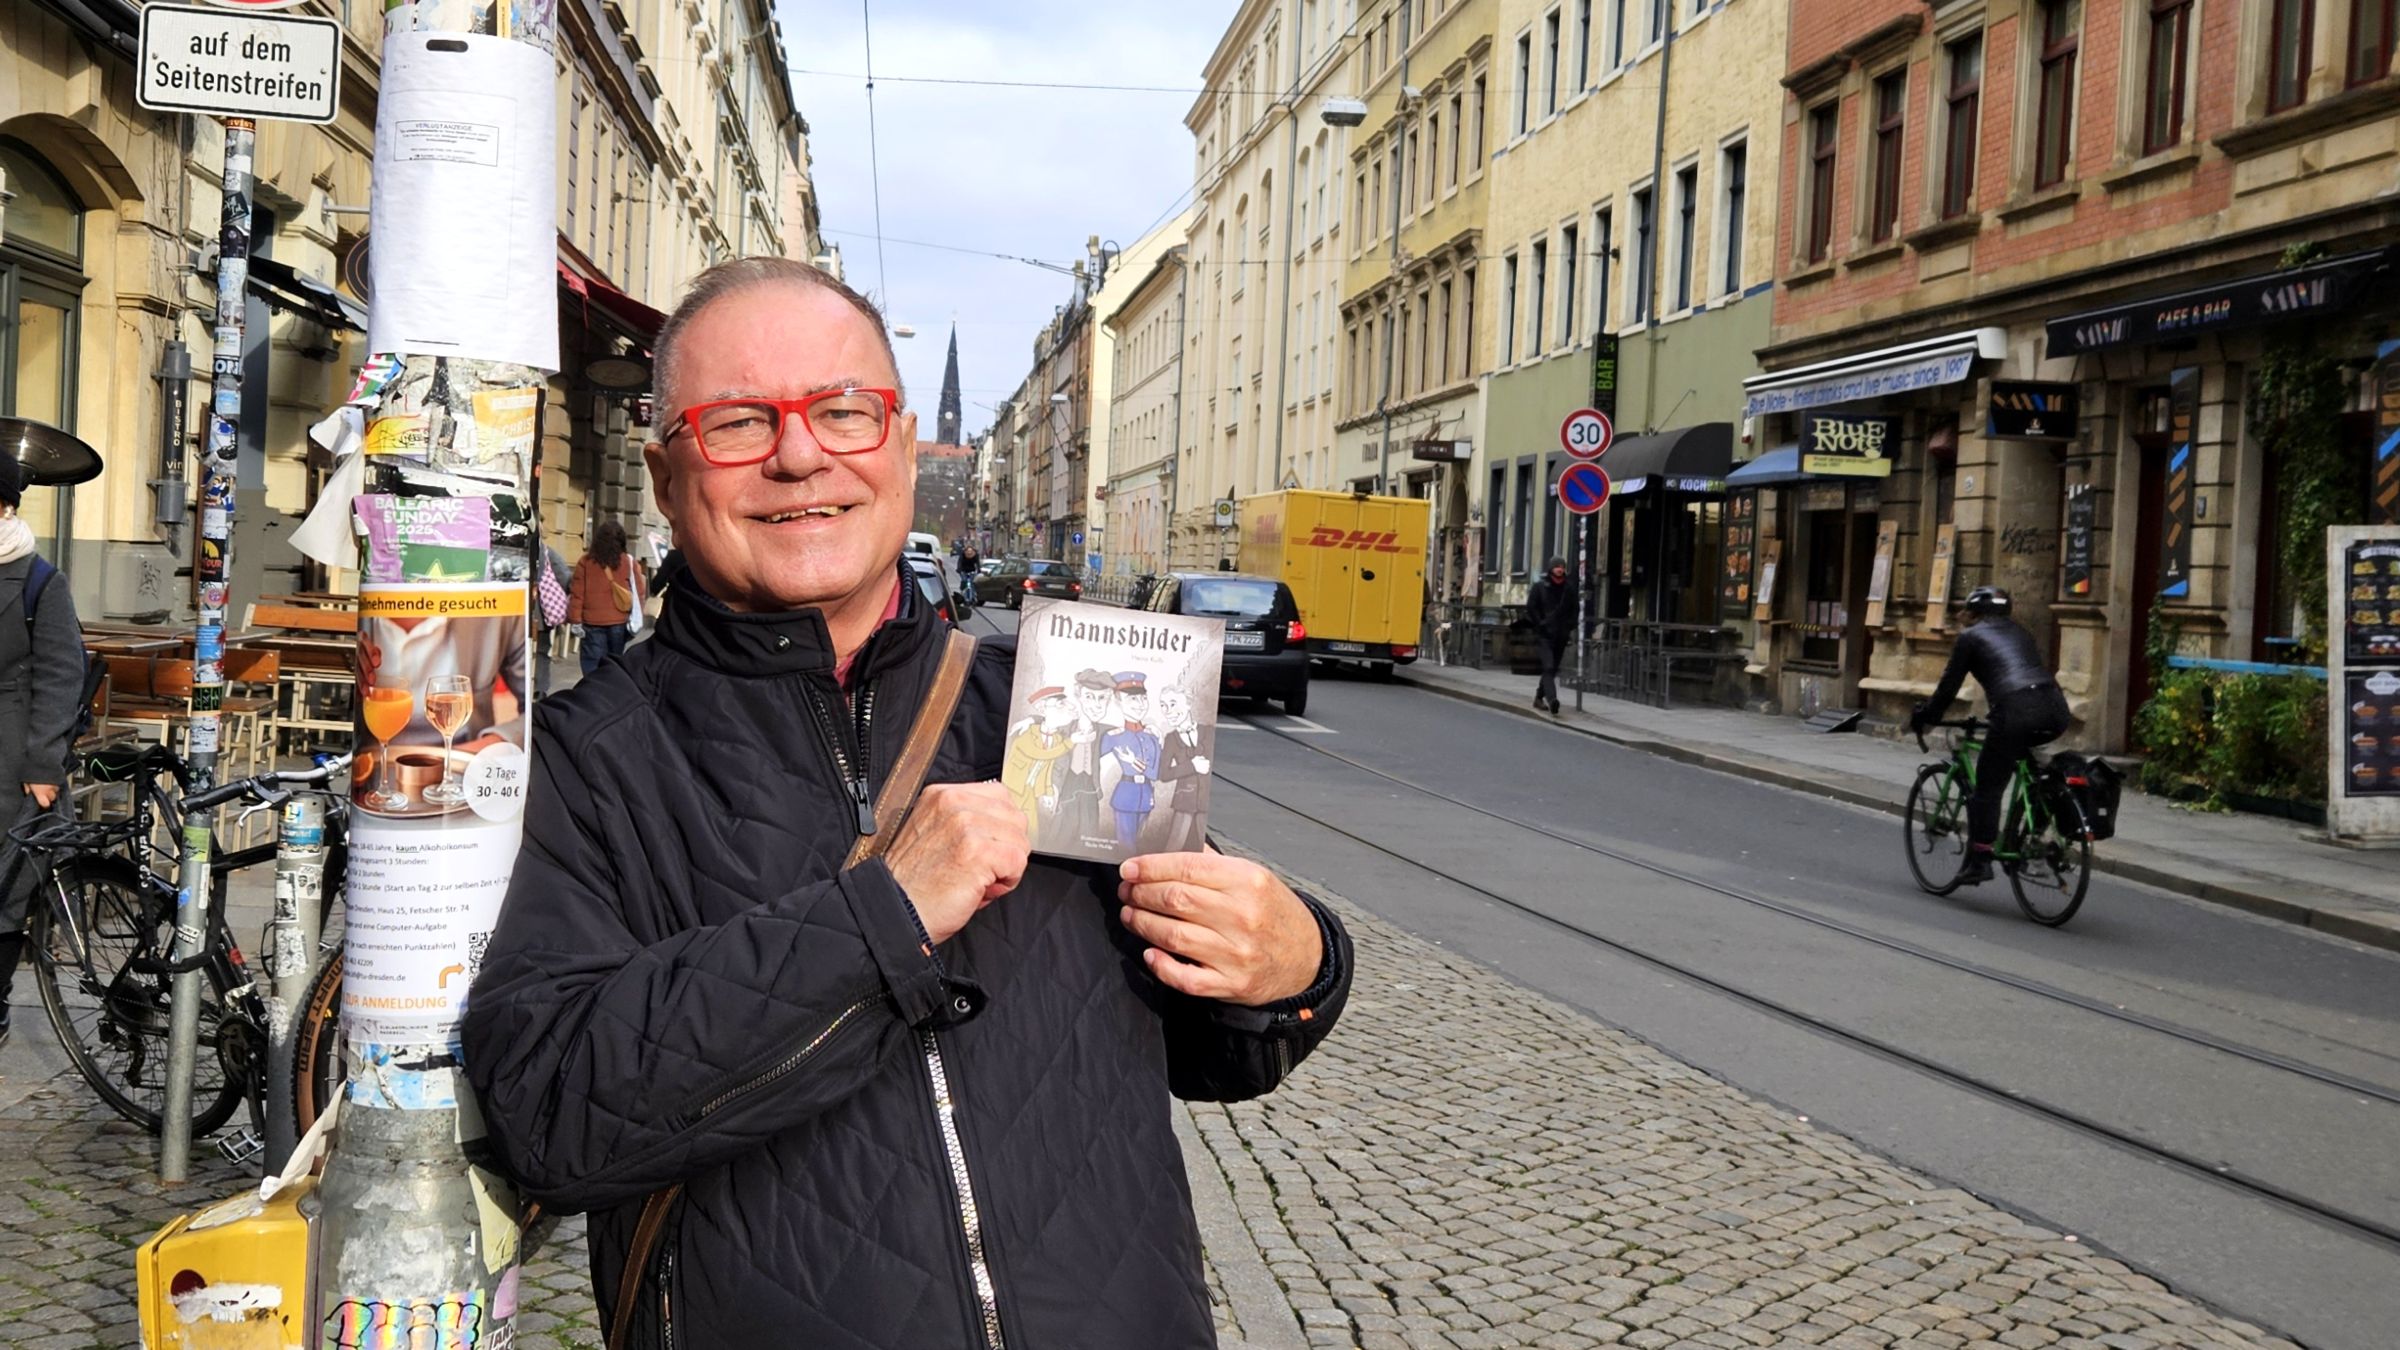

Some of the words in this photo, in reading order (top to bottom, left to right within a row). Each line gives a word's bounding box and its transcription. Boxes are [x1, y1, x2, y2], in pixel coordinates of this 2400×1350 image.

[190, 31, 229, 57] auf
[241, 34, 292, 62] dem
[154, 61, 323, 101] Seitenstreifen
[2157, 308, 2189, 331] CAFE
[2192, 305, 2200, 324] &
[2203, 298, 2231, 322] BAR
[1844, 379, 1862, 397] and
[1864, 376, 1881, 395] live
[1881, 371, 1912, 391] music
[1913, 367, 1940, 385] since
[173, 399, 182, 447] BISTRO
[1571, 422, 1601, 446] 30
[375, 497, 464, 512] BALEARIC
[383, 511, 458, 524] SUNDAY
[1308, 527, 1403, 553] DHL
[439, 598, 497, 613] gesucht
[1050, 613, 1192, 653] Mannsbilder
[485, 767, 492, 778] 2
[495, 767, 517, 781] Tage
[476, 786, 491, 797] 30
[500, 786, 512, 797] 40
[514, 786, 520, 797] €
[396, 844, 418, 853] kaum
[420, 841, 479, 852] Alkoholkonsum
[418, 884, 431, 893] Tag
[454, 881, 479, 890] selben
[396, 907, 408, 915] 25,
[410, 906, 443, 914] Fetscher
[446, 905, 458, 913] Str.
[376, 922, 447, 931] Computer-Aufgabe
[368, 943, 403, 951] erreichten
[404, 942, 456, 951] Punktzahlen)
[362, 996, 447, 1009] ANMELDUNG
